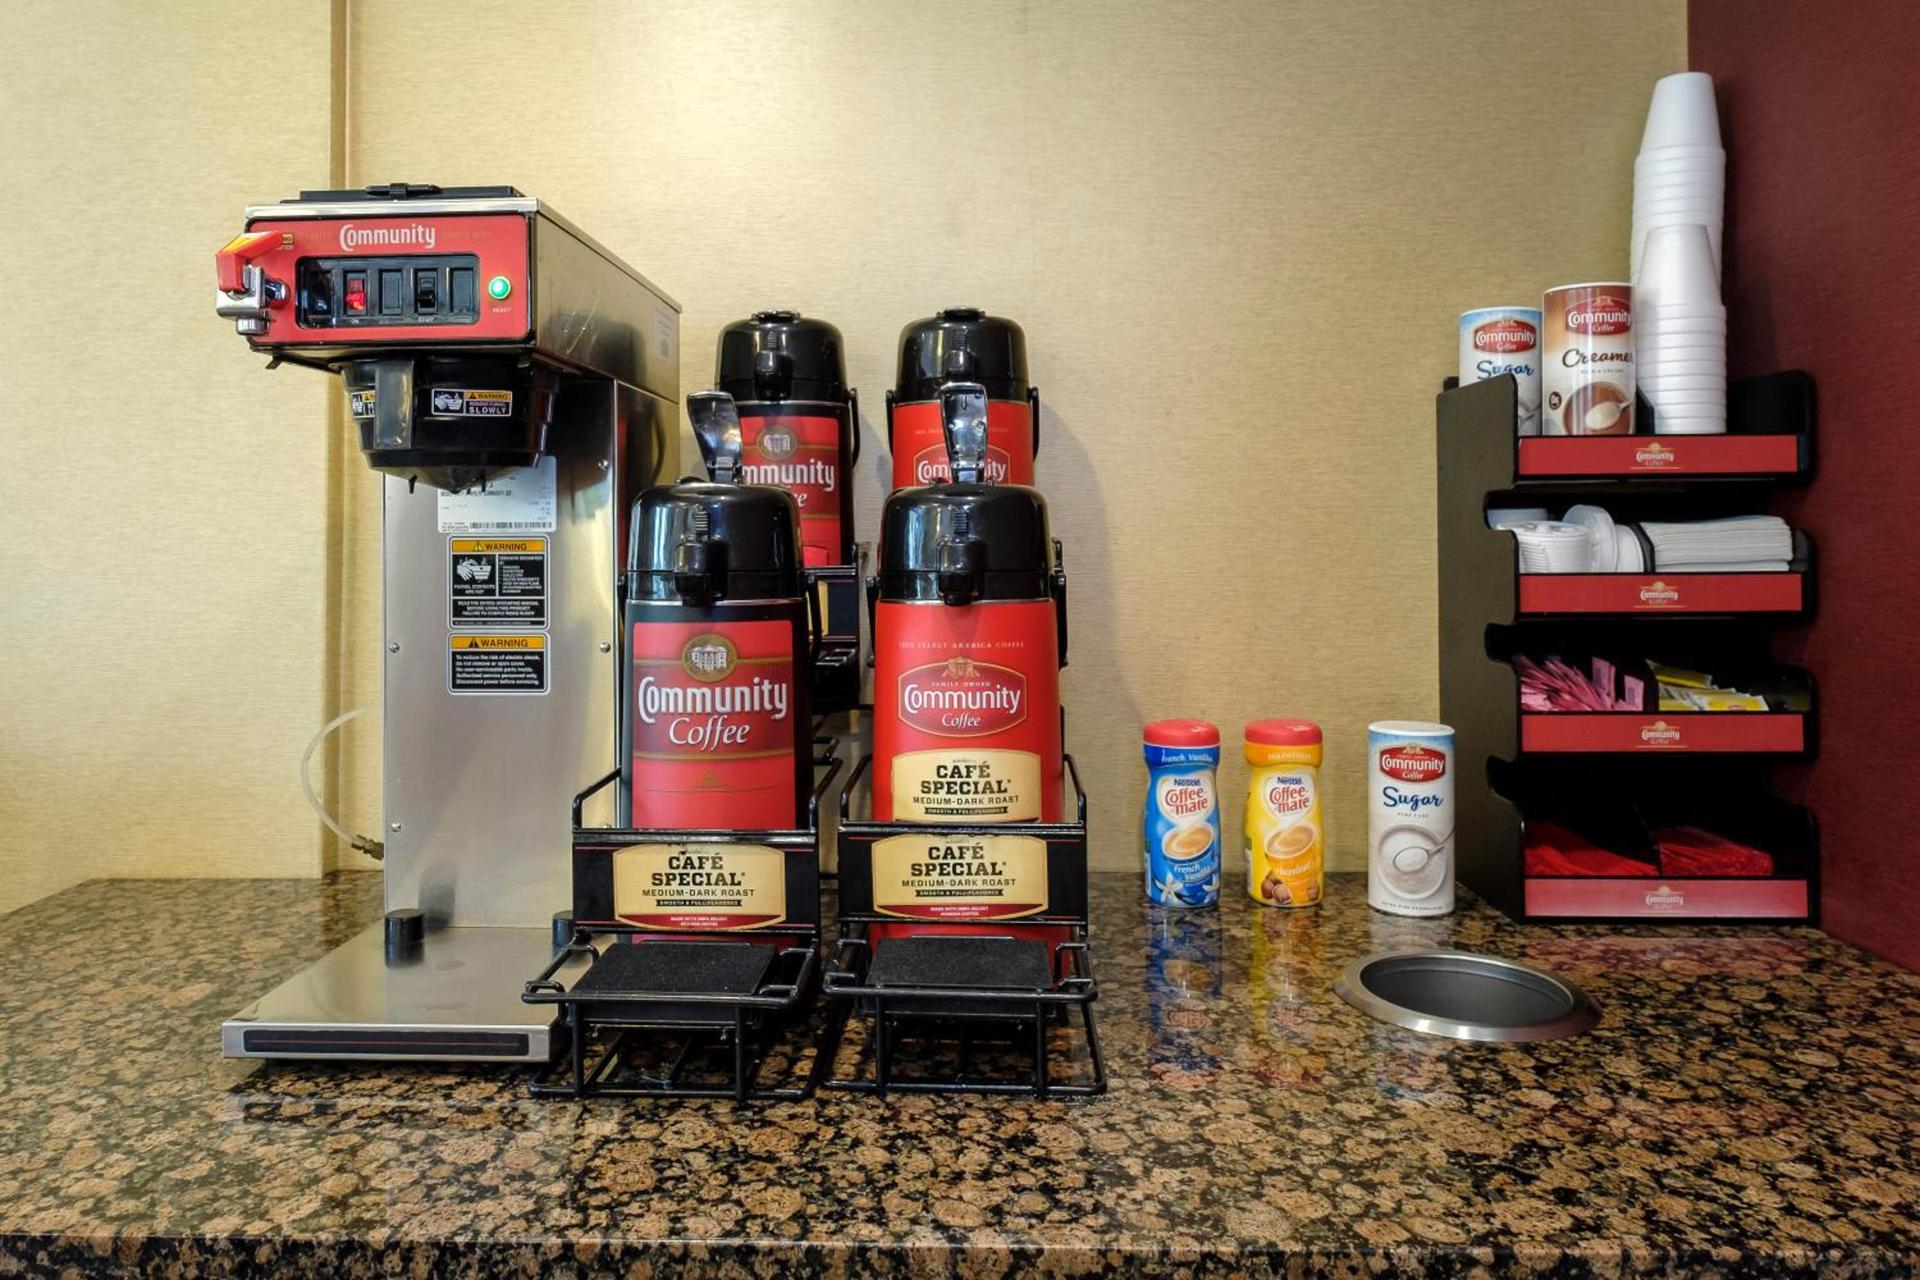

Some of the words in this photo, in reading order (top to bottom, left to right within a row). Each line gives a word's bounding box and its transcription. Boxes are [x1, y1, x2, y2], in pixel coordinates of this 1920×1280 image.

[340, 224, 435, 251] Community
[1568, 310, 1632, 327] Community
[1476, 330, 1535, 346] Community
[742, 458, 835, 492] mmunity
[917, 459, 1006, 484] Comity
[485, 543, 527, 551] WARNING
[481, 639, 528, 648] WARNING
[639, 676, 787, 724] Community
[905, 684, 1021, 714] Community
[942, 712, 981, 728] Coffee
[668, 715, 750, 751] Coffee
[936, 761, 991, 779] CAFÉ
[1381, 755, 1444, 773] Community
[920, 780, 1008, 795] SPECIAL
[1269, 786, 1306, 805] Coffee
[913, 796, 985, 805] MEDIUM-DARK
[988, 795, 1019, 804] ROAST
[1165, 787, 1204, 806] Coffee
[1278, 797, 1310, 813] mate
[1383, 786, 1444, 811] Sugar
[1176, 798, 1208, 815] mate
[928, 842, 984, 860] CAFÉ
[668, 853, 724, 870] CAFÉ
[911, 862, 1003, 877] SPECIAL
[651, 872, 742, 886] SPECIAL
[902, 878, 978, 887] MEDIUM-DARK
[982, 878, 1016, 886] ROAST
[642, 889, 717, 897] MEDIUM-DARK
[721, 889, 755, 897] ROAST
